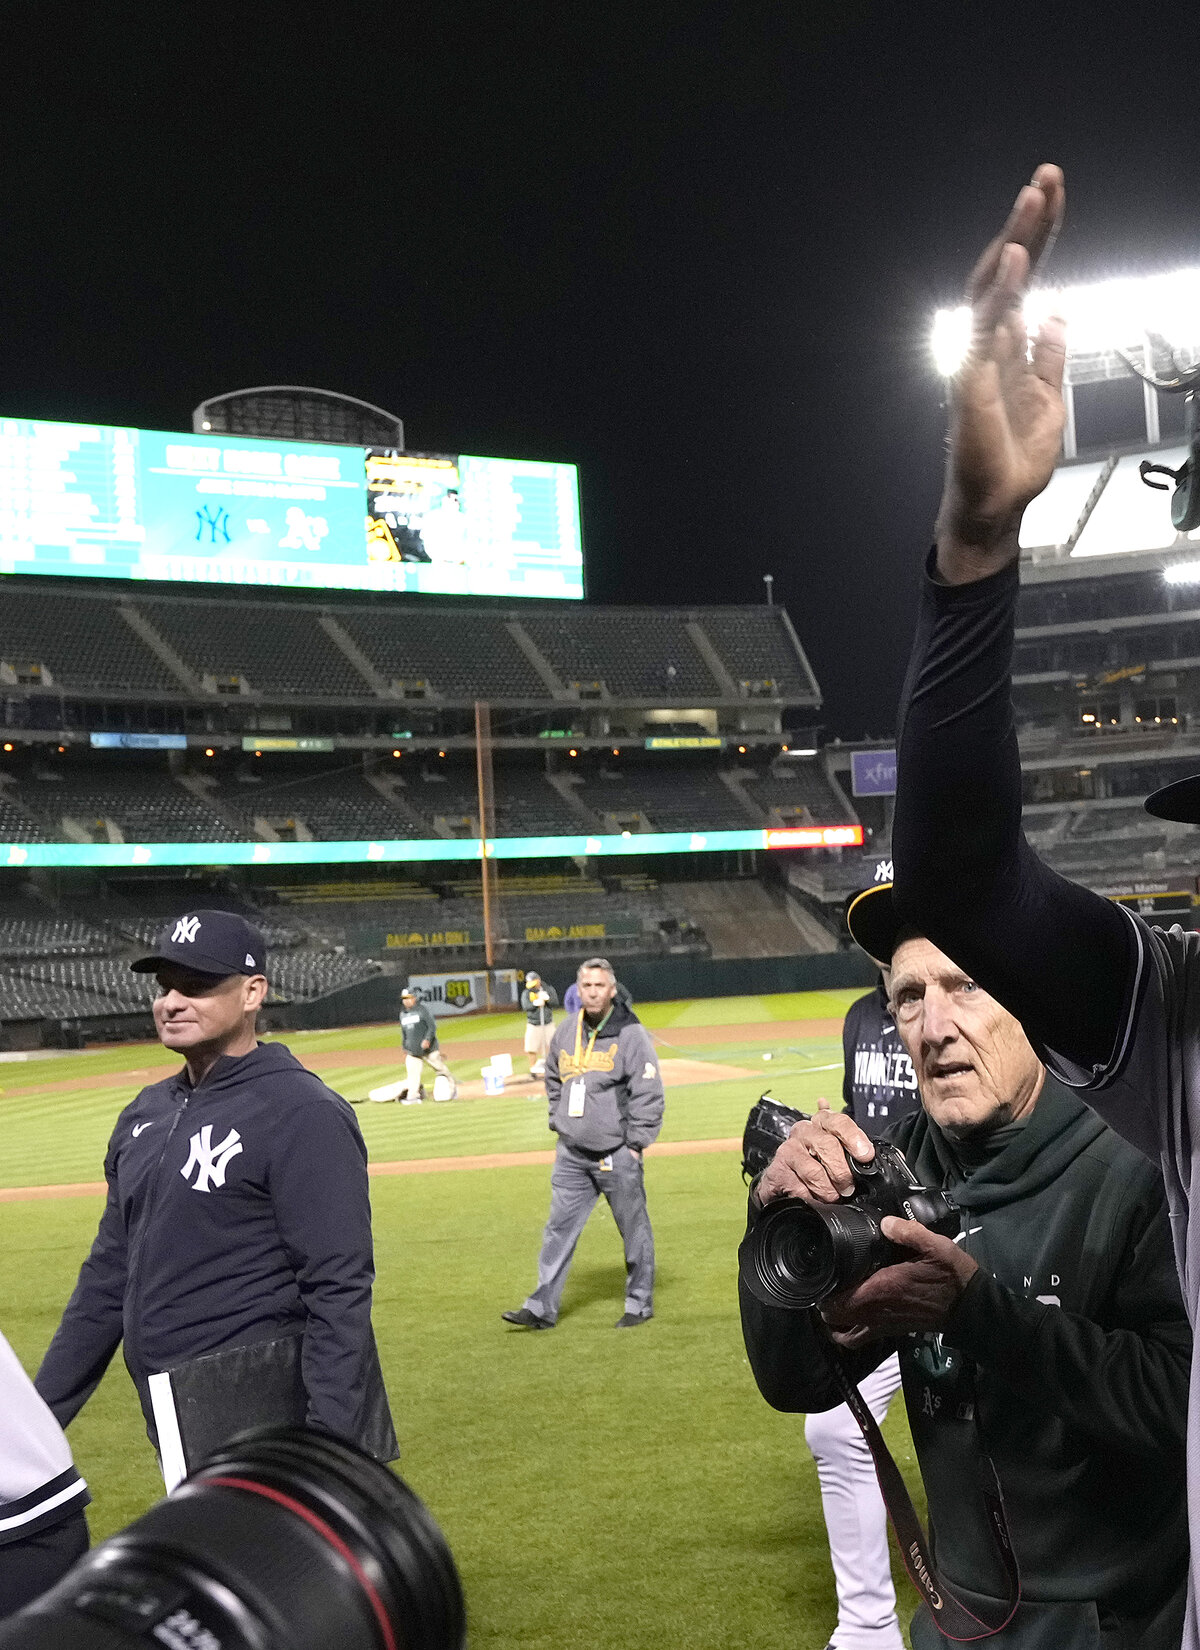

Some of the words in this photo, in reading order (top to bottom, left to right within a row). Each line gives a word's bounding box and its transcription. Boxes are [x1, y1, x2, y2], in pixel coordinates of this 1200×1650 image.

[171, 915, 202, 943] NY
[446, 981, 470, 1000] 811
[180, 1124, 243, 1193] NY
[909, 1541, 944, 1610] Canon
